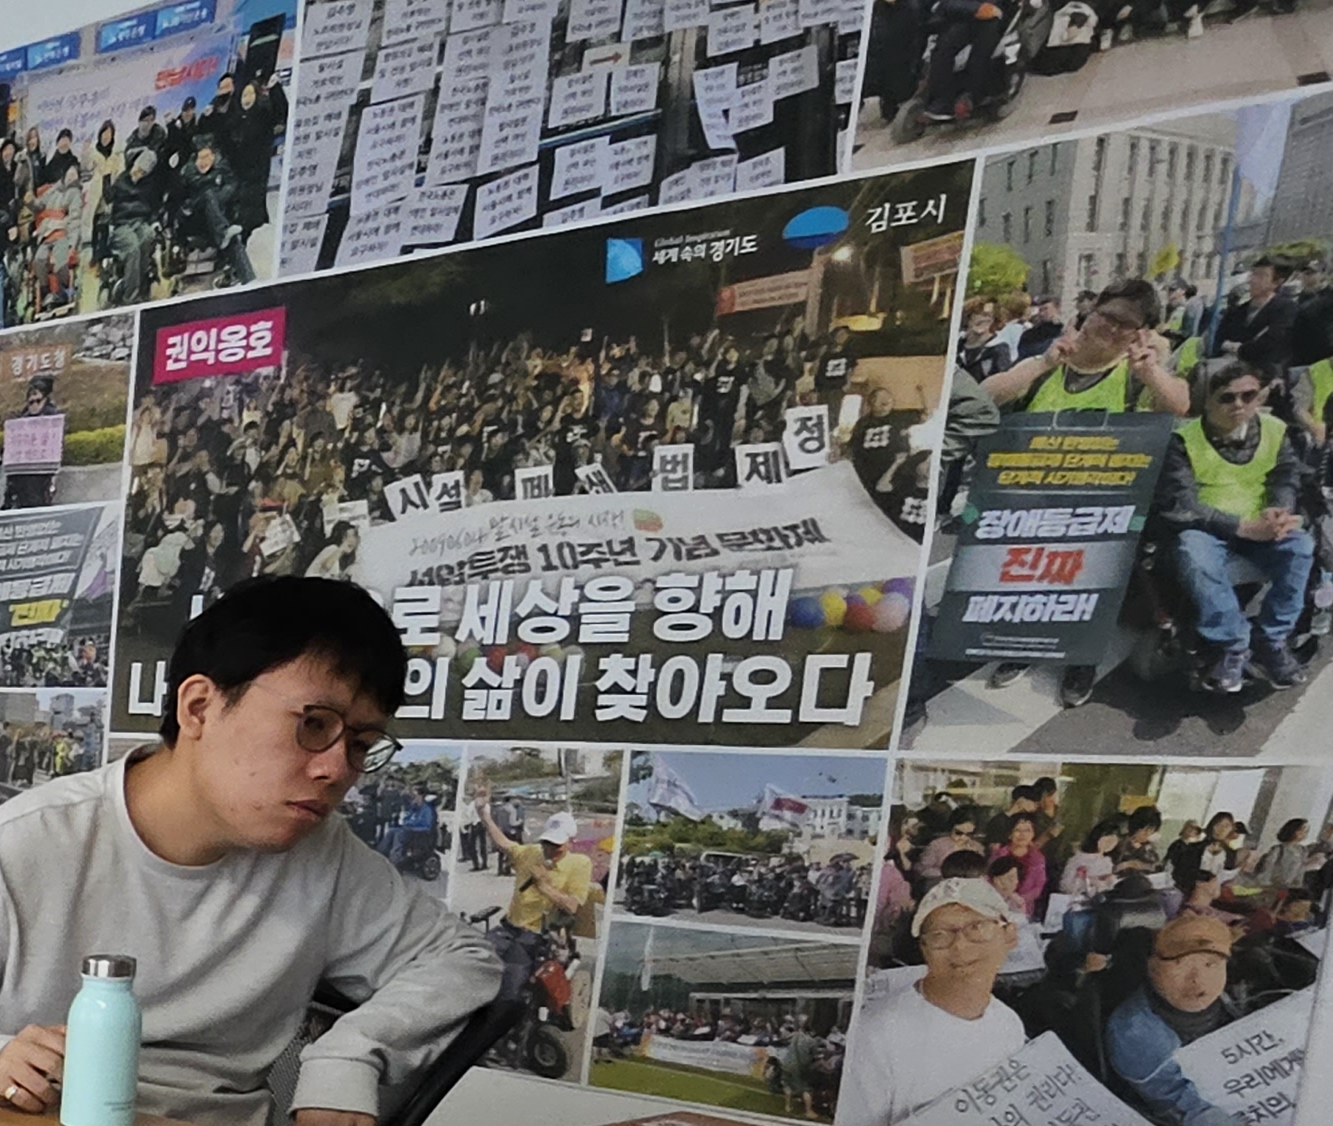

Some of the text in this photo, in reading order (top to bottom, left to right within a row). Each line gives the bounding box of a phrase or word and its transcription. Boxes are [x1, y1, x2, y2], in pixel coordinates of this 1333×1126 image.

[864, 192, 948, 234] 김포시
[709, 233, 759, 263] 경기도
[165, 319, 275, 372] 권익옹호
[794, 414, 826, 454] 정
[659, 452, 690, 492] 법
[974, 505, 1136, 539] 장애등급제
[536, 535, 641, 572] 10주년
[645, 532, 721, 562] 기념
[998, 546, 1085, 585] 진짜
[455, 575, 637, 647] 세상을
[652, 567, 793, 644] 향해
[461, 654, 581, 722] 삶이
[594, 651, 874, 727] 찾아오다
[954, 1056, 1031, 1116] 이동권은
